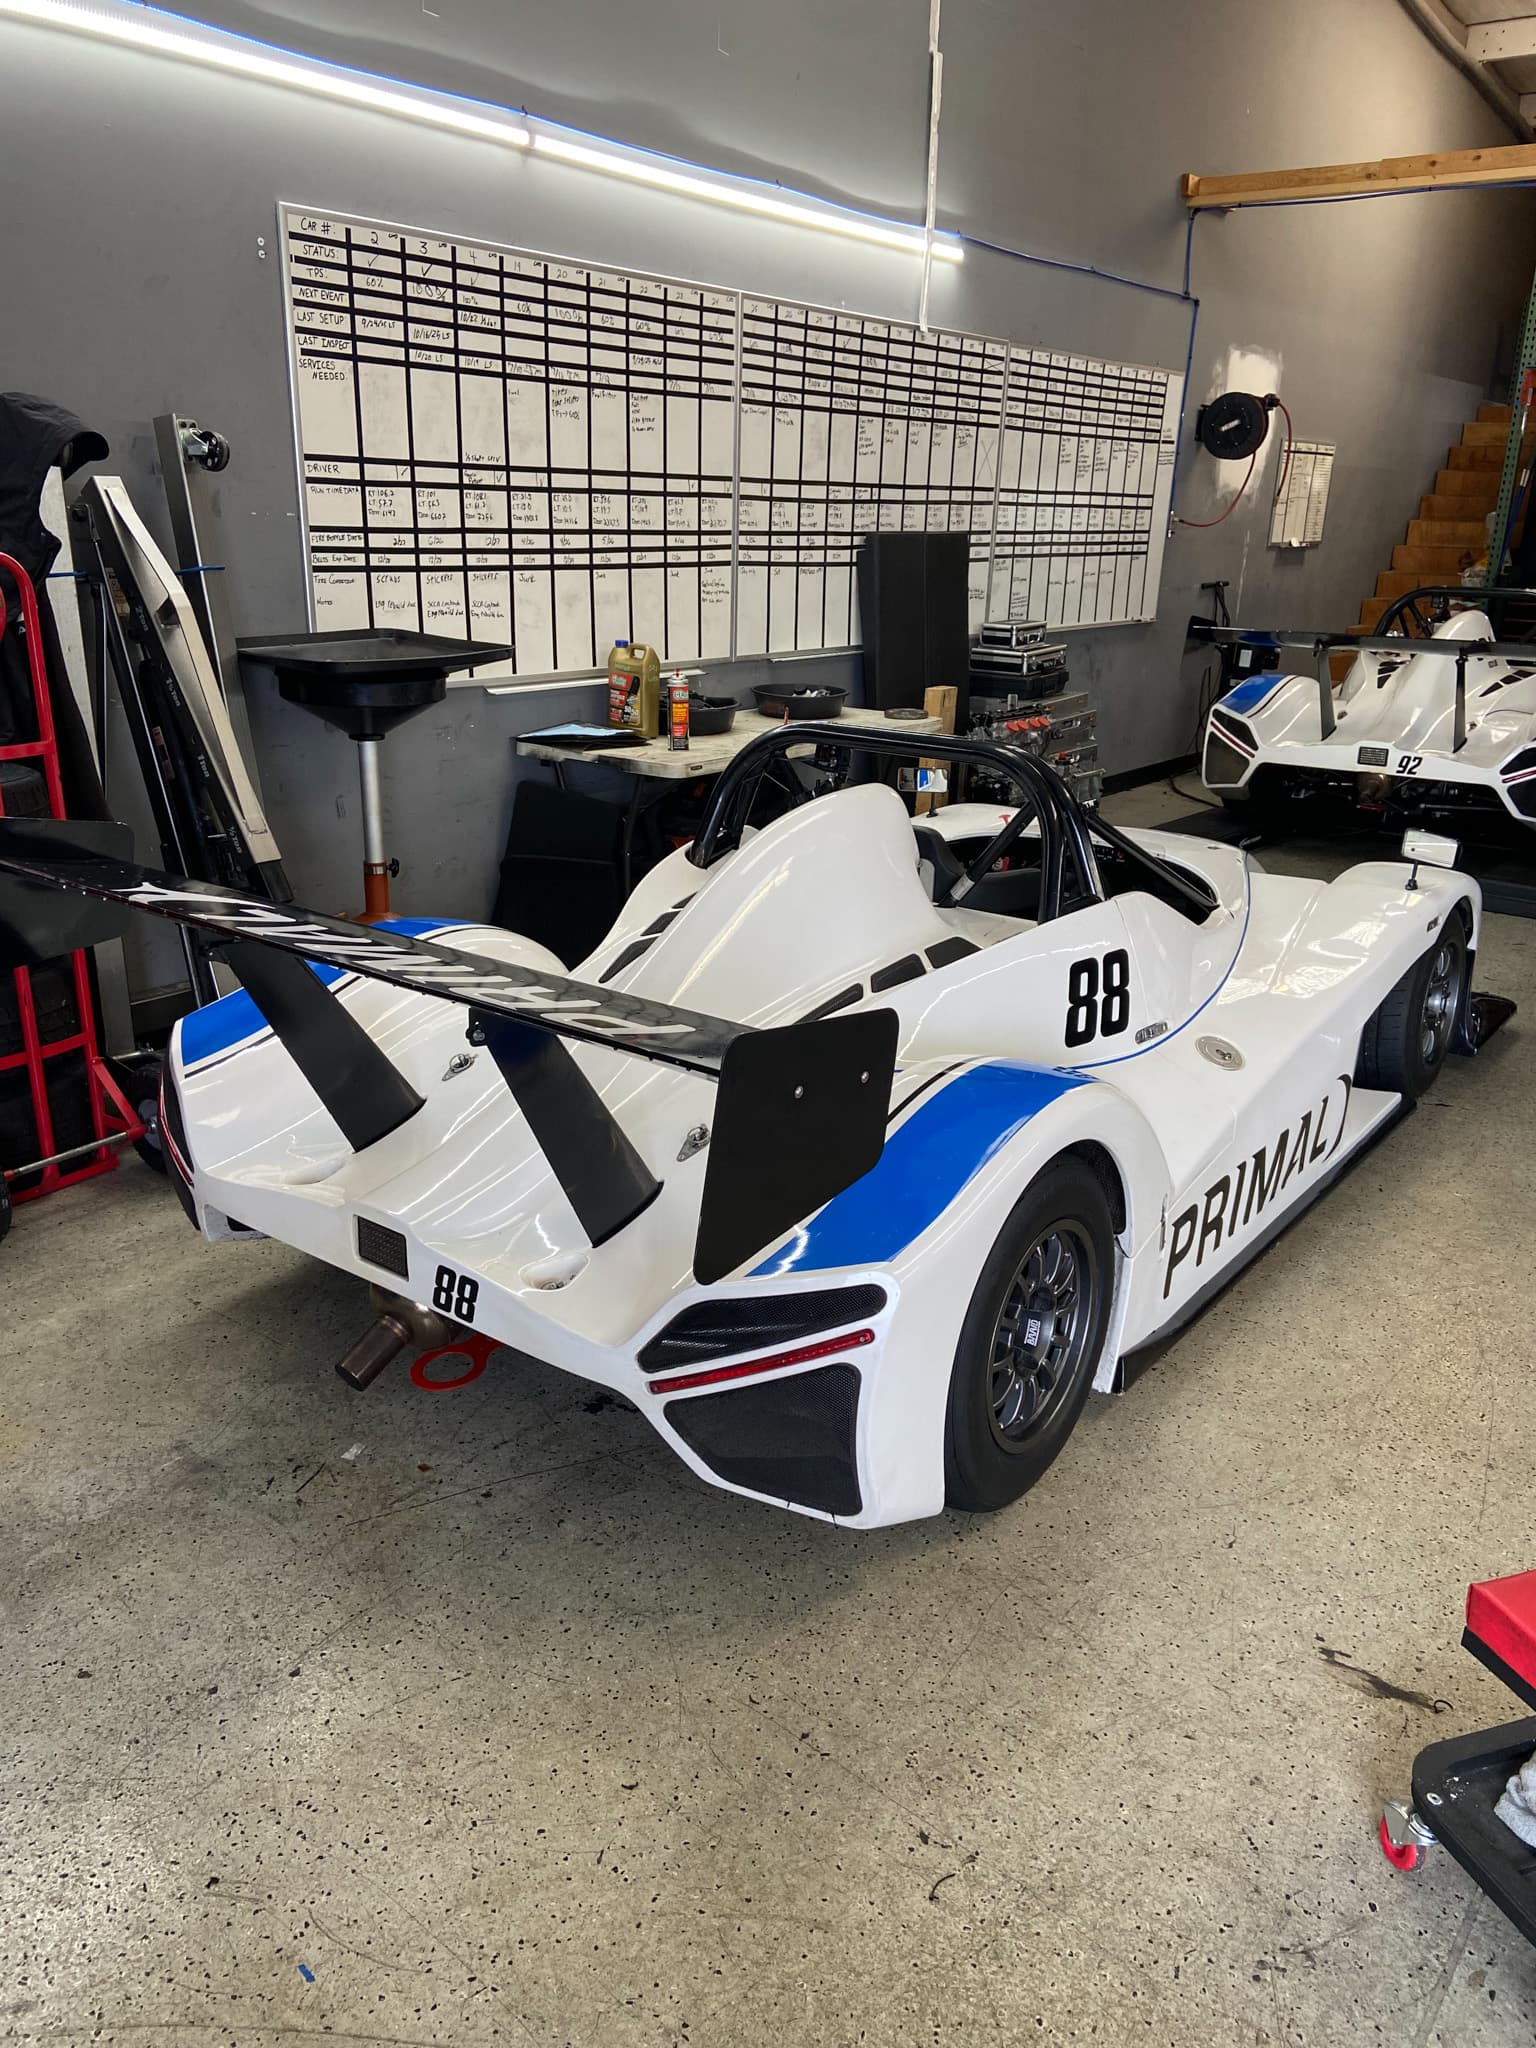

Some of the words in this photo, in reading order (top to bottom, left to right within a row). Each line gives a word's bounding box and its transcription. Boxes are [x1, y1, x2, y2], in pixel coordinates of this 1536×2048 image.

[371, 231, 379, 245] 2
[419, 241, 428, 254] 3
[469, 250, 478, 264] 4
[299, 287, 318, 299] NEXT
[320, 289, 345, 303] EVENT
[297, 311, 315, 323] LAST
[319, 312, 345, 326] SETUP
[298, 336, 318, 348] LAST
[298, 358, 336, 370] SERVICES
[307, 464, 341, 475] DRIVER
[1395, 755, 1423, 776] 92
[1064, 948, 1130, 1048] 88
[432, 1264, 480, 1324] 88
